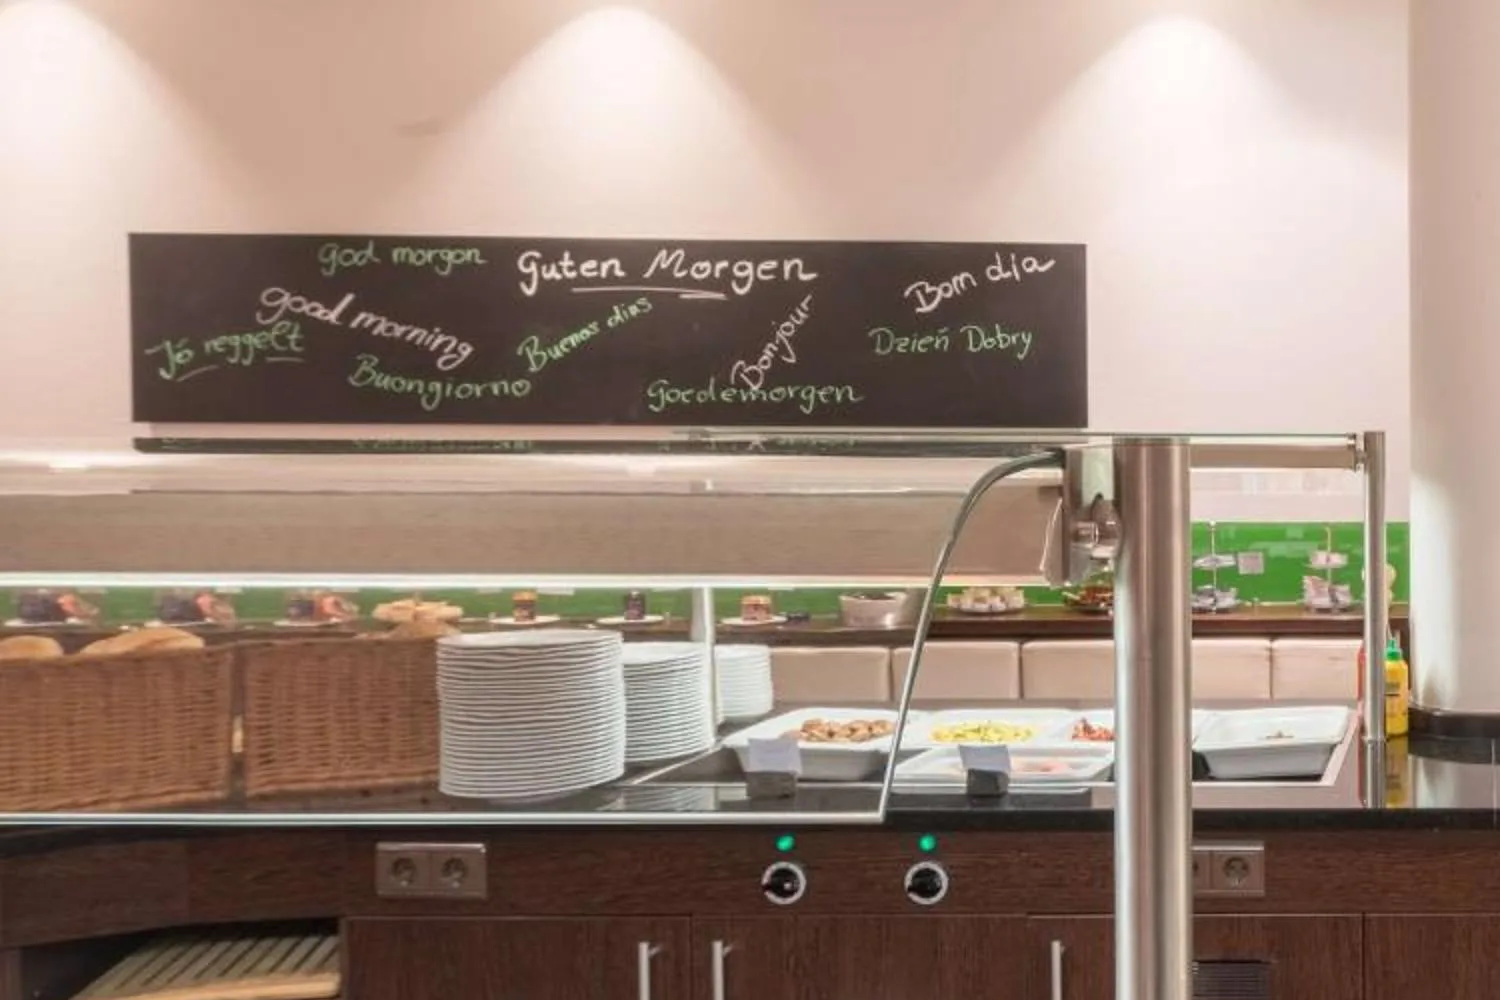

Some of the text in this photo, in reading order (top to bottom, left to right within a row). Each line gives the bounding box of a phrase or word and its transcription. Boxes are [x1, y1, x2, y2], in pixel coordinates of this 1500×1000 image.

[392, 246, 489, 276] morgon
[516, 248, 820, 297] Guten Morgen
[903, 252, 1057, 314] Bom dia
[203, 320, 306, 367] reggelt
[348, 311, 476, 372] morning
[515, 320, 602, 374] Buenas
[729, 293, 814, 391] Bonjour
[959, 323, 1034, 361] Dobry
[347, 353, 533, 412] Buongiorno
